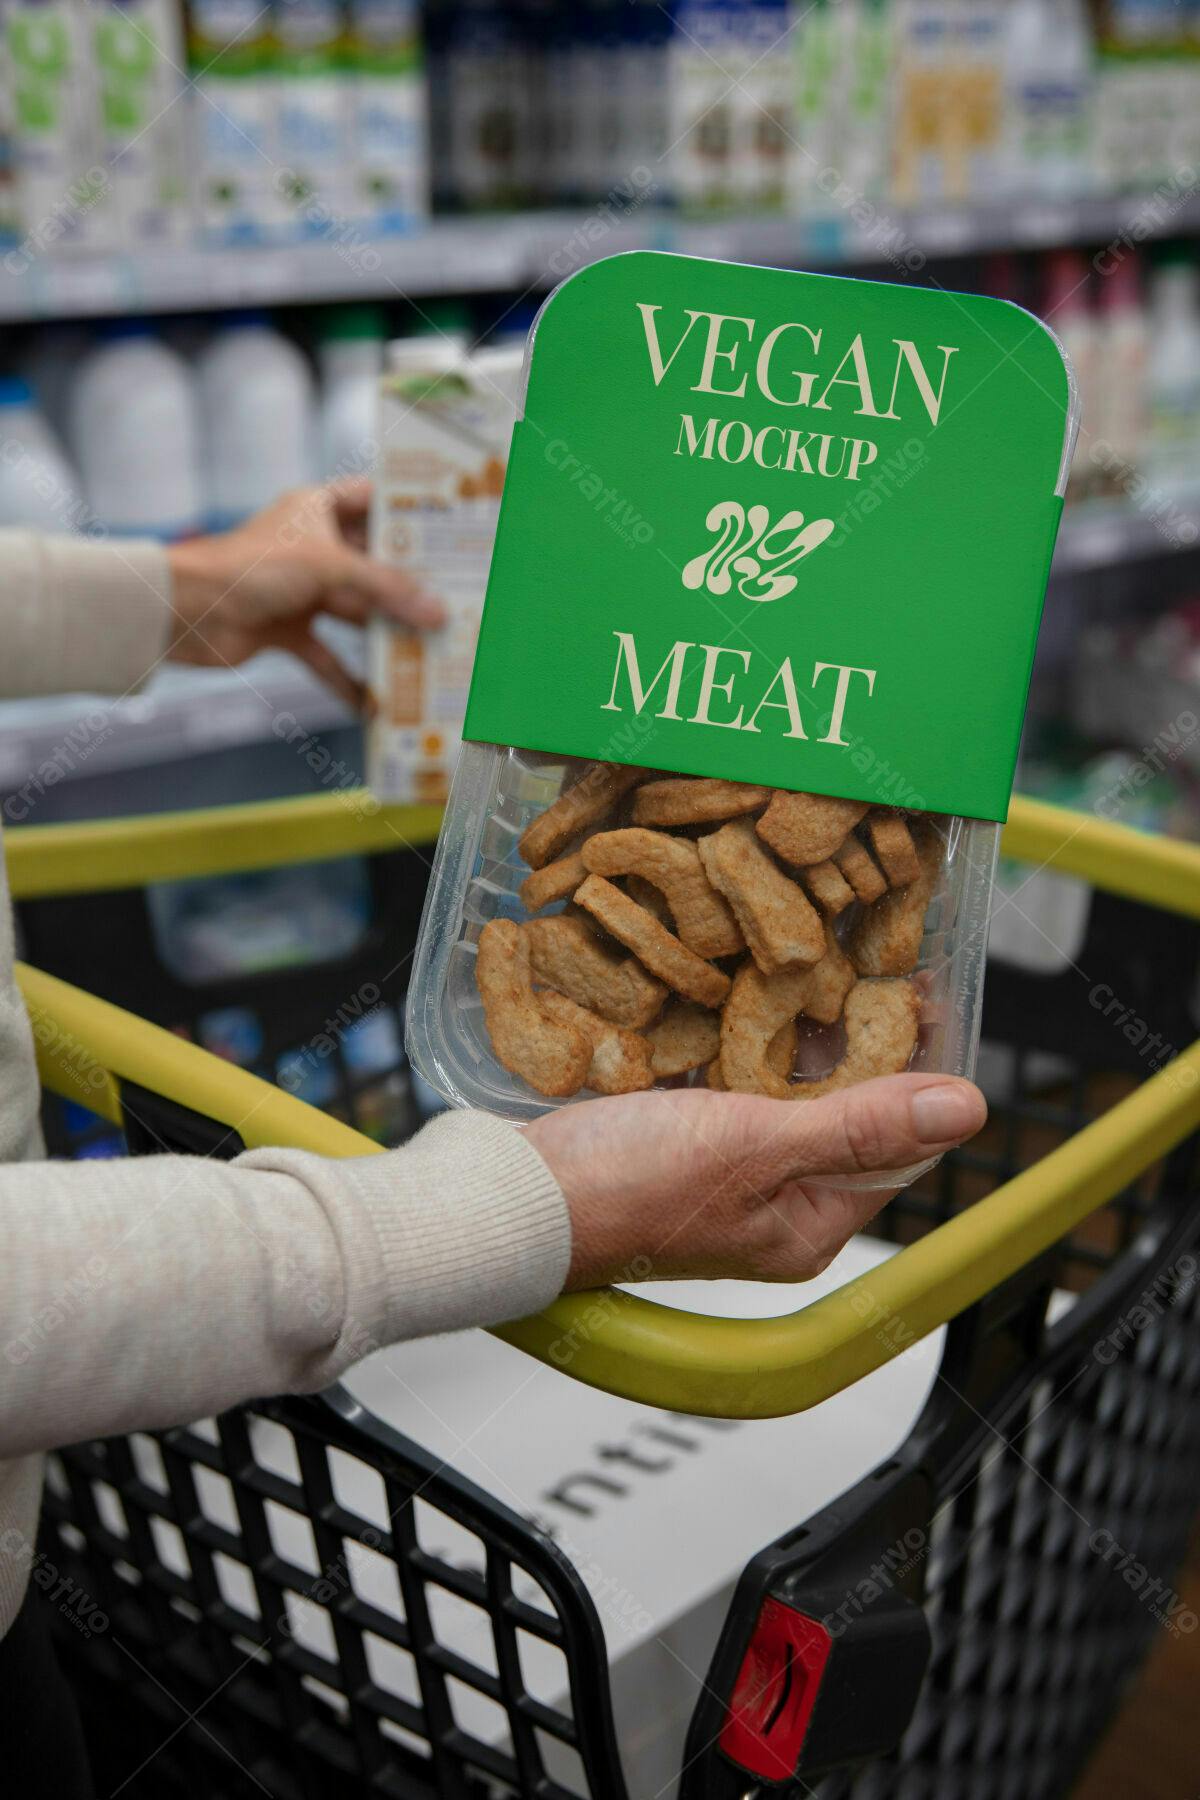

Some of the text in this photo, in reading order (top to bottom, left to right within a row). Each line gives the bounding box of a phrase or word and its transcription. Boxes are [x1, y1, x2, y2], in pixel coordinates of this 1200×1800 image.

[636, 302, 960, 426] VEGAN
[673, 413, 878, 481] MOCKUP
[600, 630, 877, 747] MEAT
